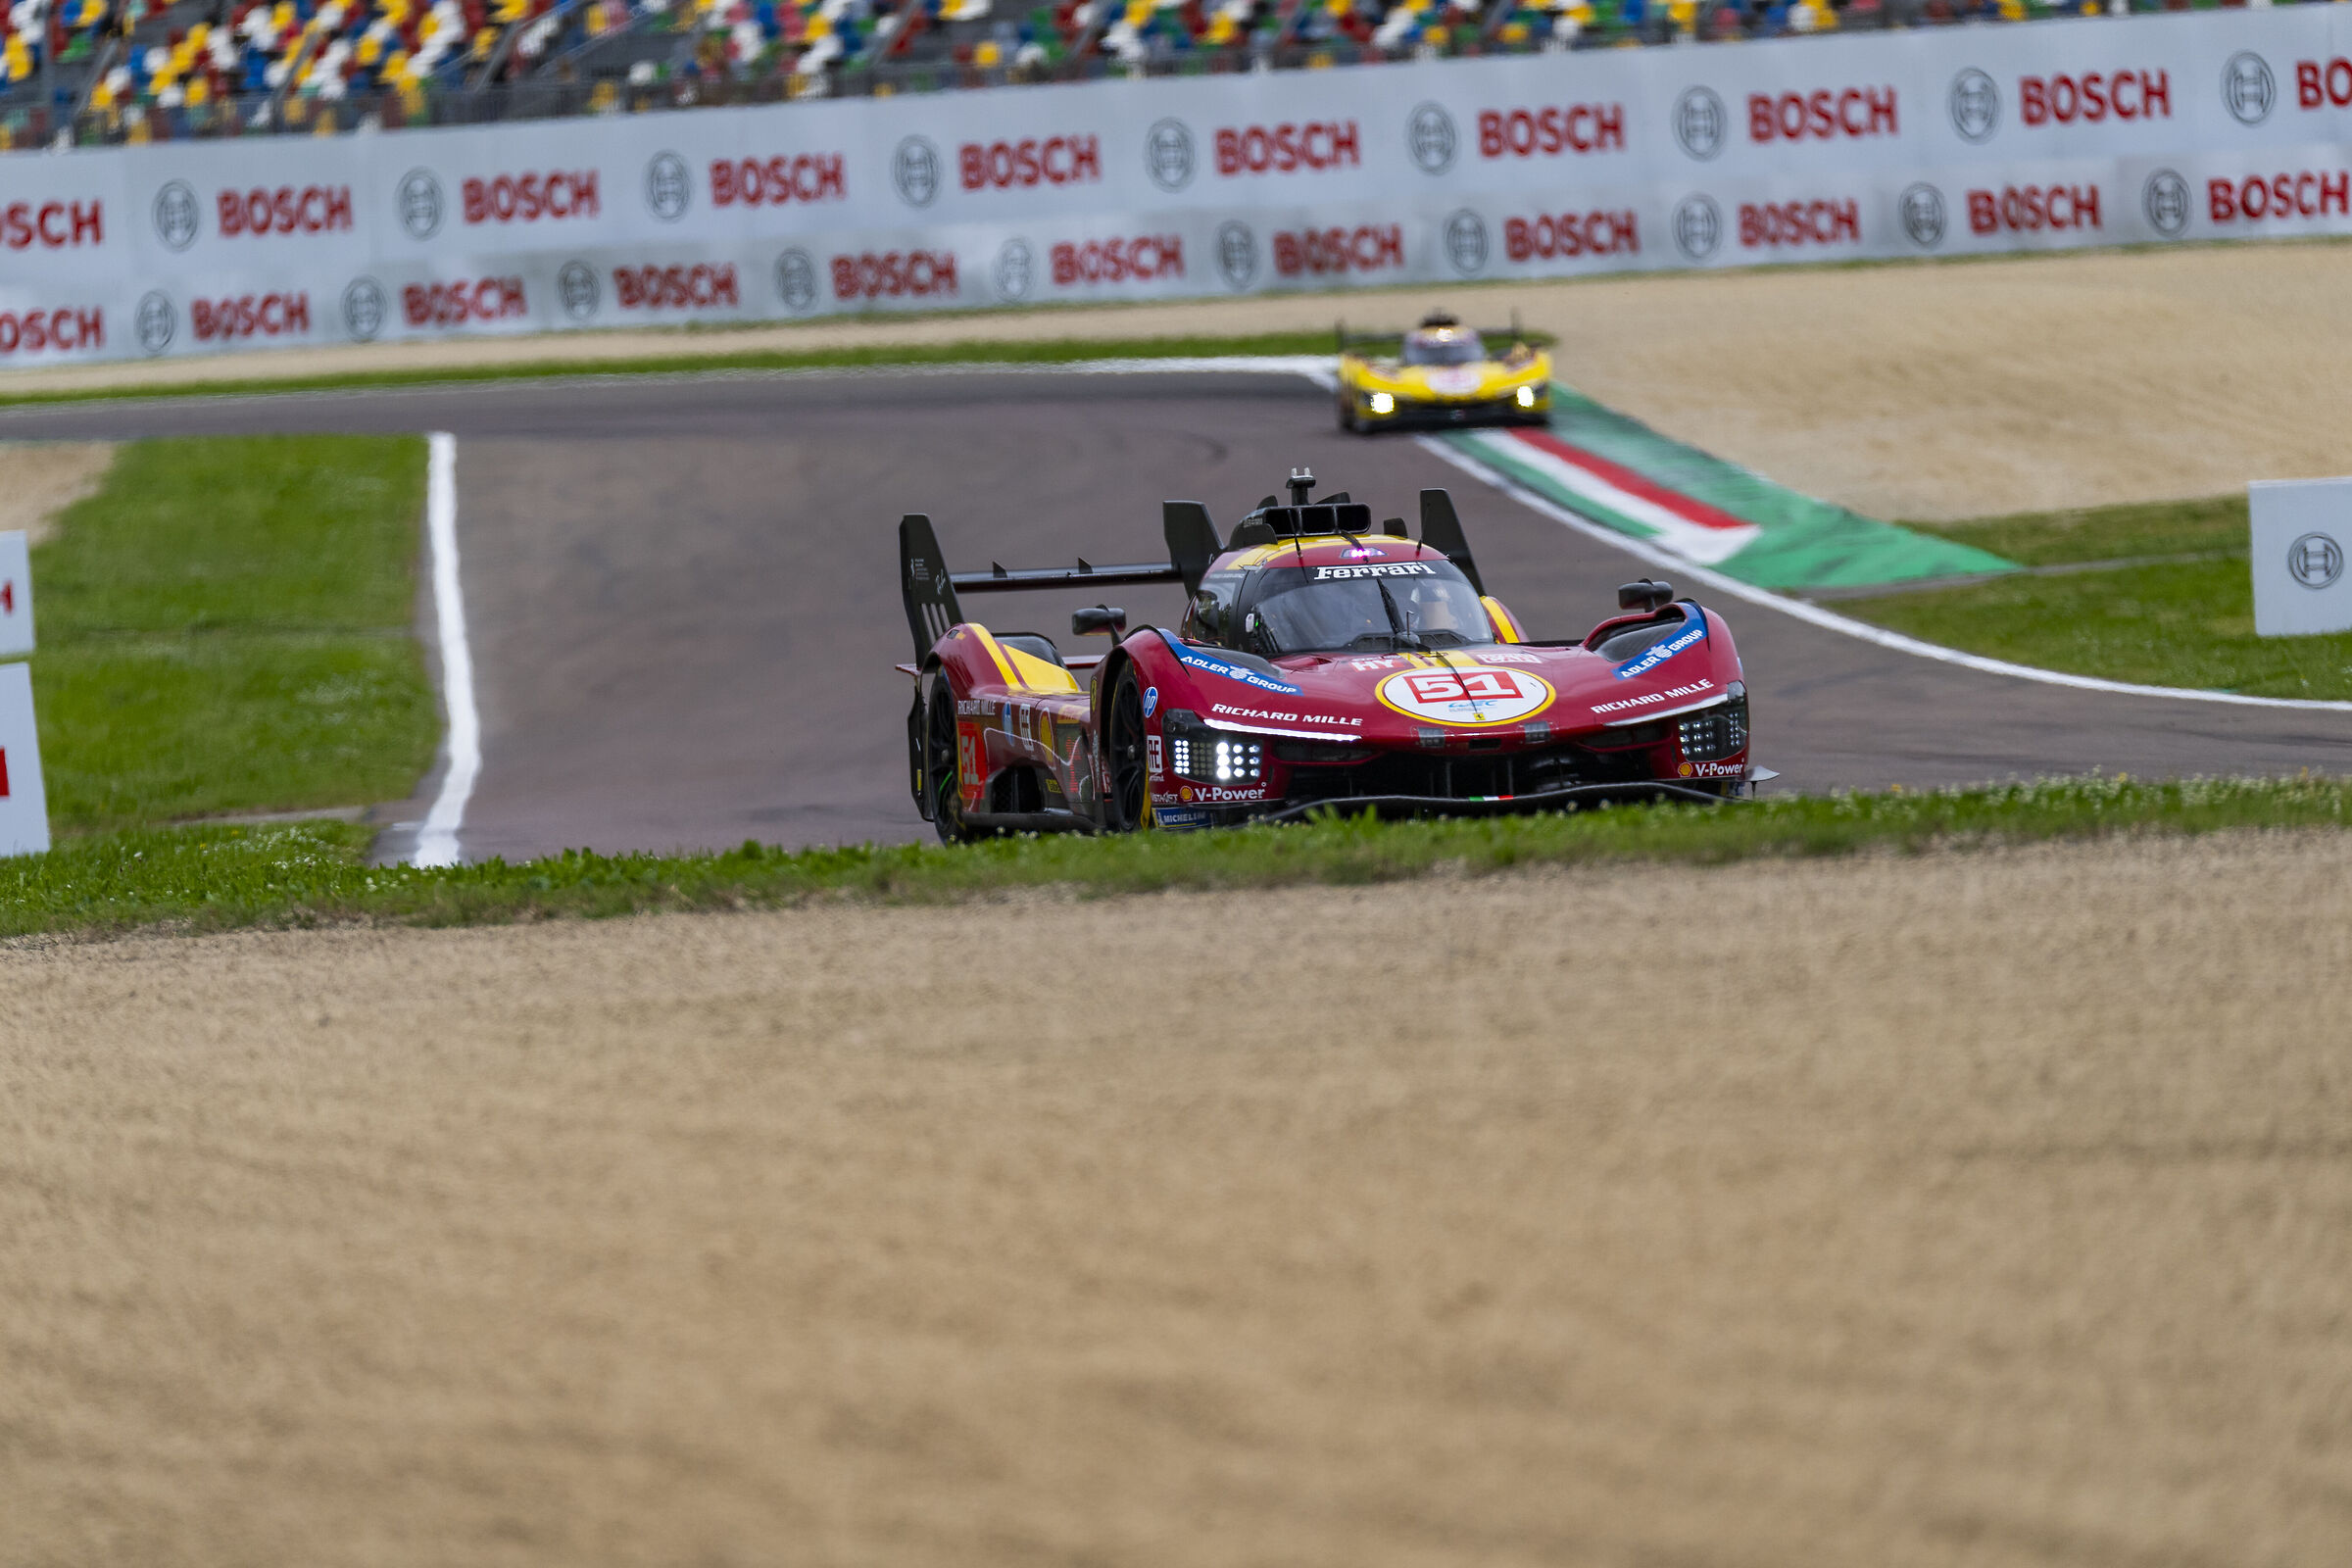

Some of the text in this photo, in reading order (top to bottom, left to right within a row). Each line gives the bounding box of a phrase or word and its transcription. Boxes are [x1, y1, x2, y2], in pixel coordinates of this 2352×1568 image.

[1748, 88, 1896, 141] BOSCH
[2021, 71, 2170, 125] BOSCH
[1215, 122, 1359, 174] BOSCH
[1480, 107, 1623, 157] BOSCH
[710, 156, 844, 206] BOSCH
[960, 137, 1099, 189] BOSCH
[220, 188, 351, 235] BOSCH
[465, 173, 597, 223] BOSCH
[1968, 186, 2100, 234] BOSCH
[2208, 172, 2350, 223] BOSCH
[0, 202, 102, 249] SCH
[1507, 211, 1637, 261] BOSCH
[1740, 200, 1859, 247] BOSCH
[1053, 237, 1182, 285] BOSCH
[1274, 226, 1402, 273] BOSCH
[617, 265, 736, 307] BOSCH
[833, 253, 956, 298] BOSCH
[193, 294, 308, 338] BOSCH
[404, 278, 524, 325] BOSCH
[1314, 562, 1436, 580] Ferrari
[1180, 656, 1298, 694] ADLER GROUP
[1620, 629, 1703, 678] ADLER GROUP
[1411, 673, 1516, 700] 51
[1591, 678, 1714, 713] RICHARD MILLE
[1211, 703, 1364, 726] RICHARD MILLE
[961, 735, 979, 784] 51
[1695, 762, 1743, 777] V-Power
[1195, 787, 1266, 802] V-Power
